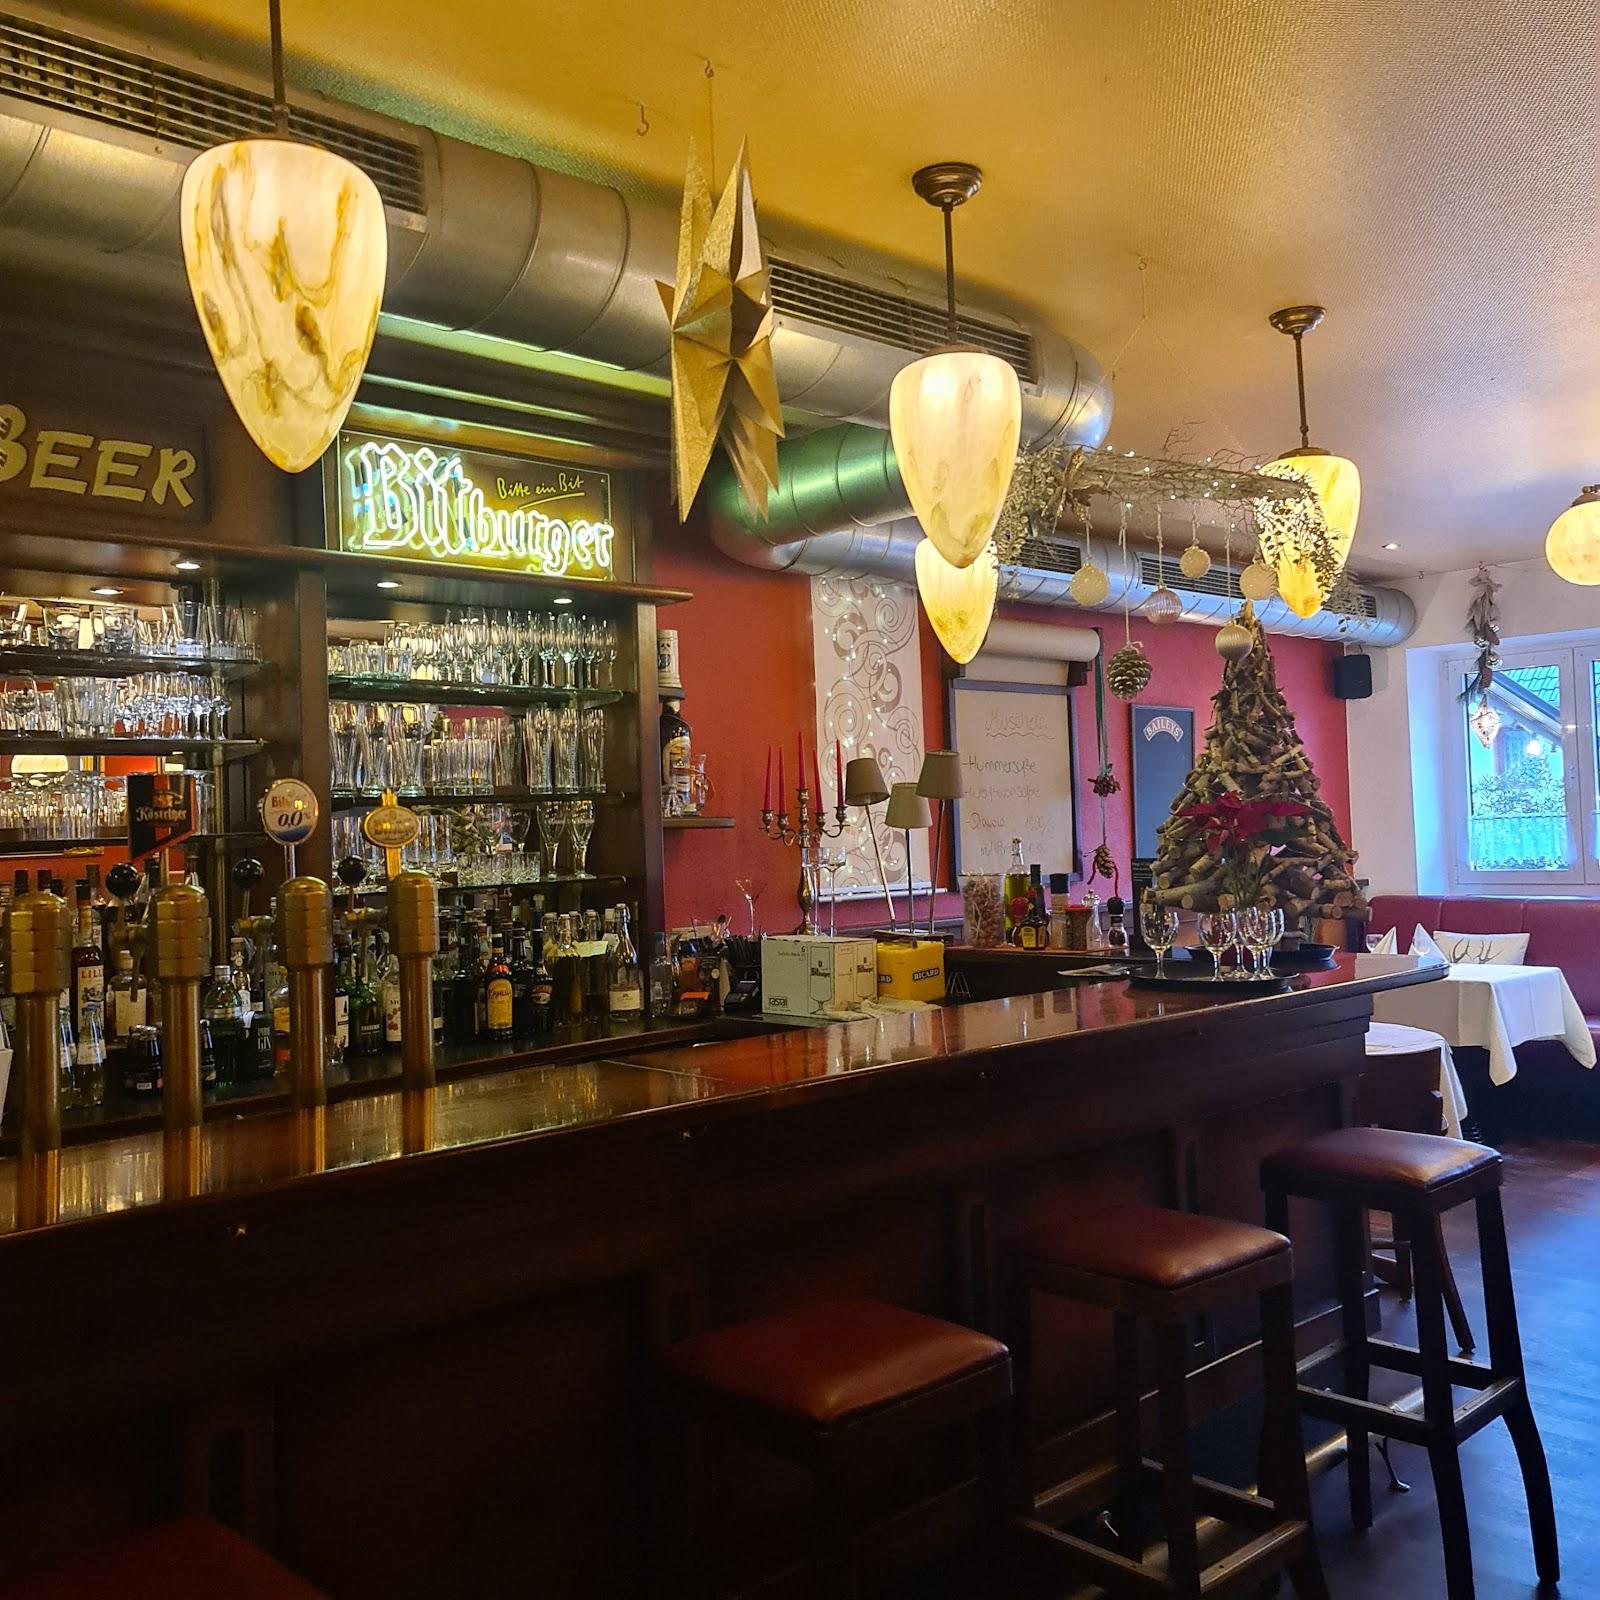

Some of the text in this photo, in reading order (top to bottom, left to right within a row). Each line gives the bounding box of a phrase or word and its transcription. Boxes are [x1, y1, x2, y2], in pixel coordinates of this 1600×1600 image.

[0, 404, 197, 508] BEER
[496, 472, 585, 500] Bitte ein Bit
[345, 441, 614, 577] Bitburger
[1146, 718, 1180, 737] BAILEYS
[913, 968, 939, 980] RICARD
